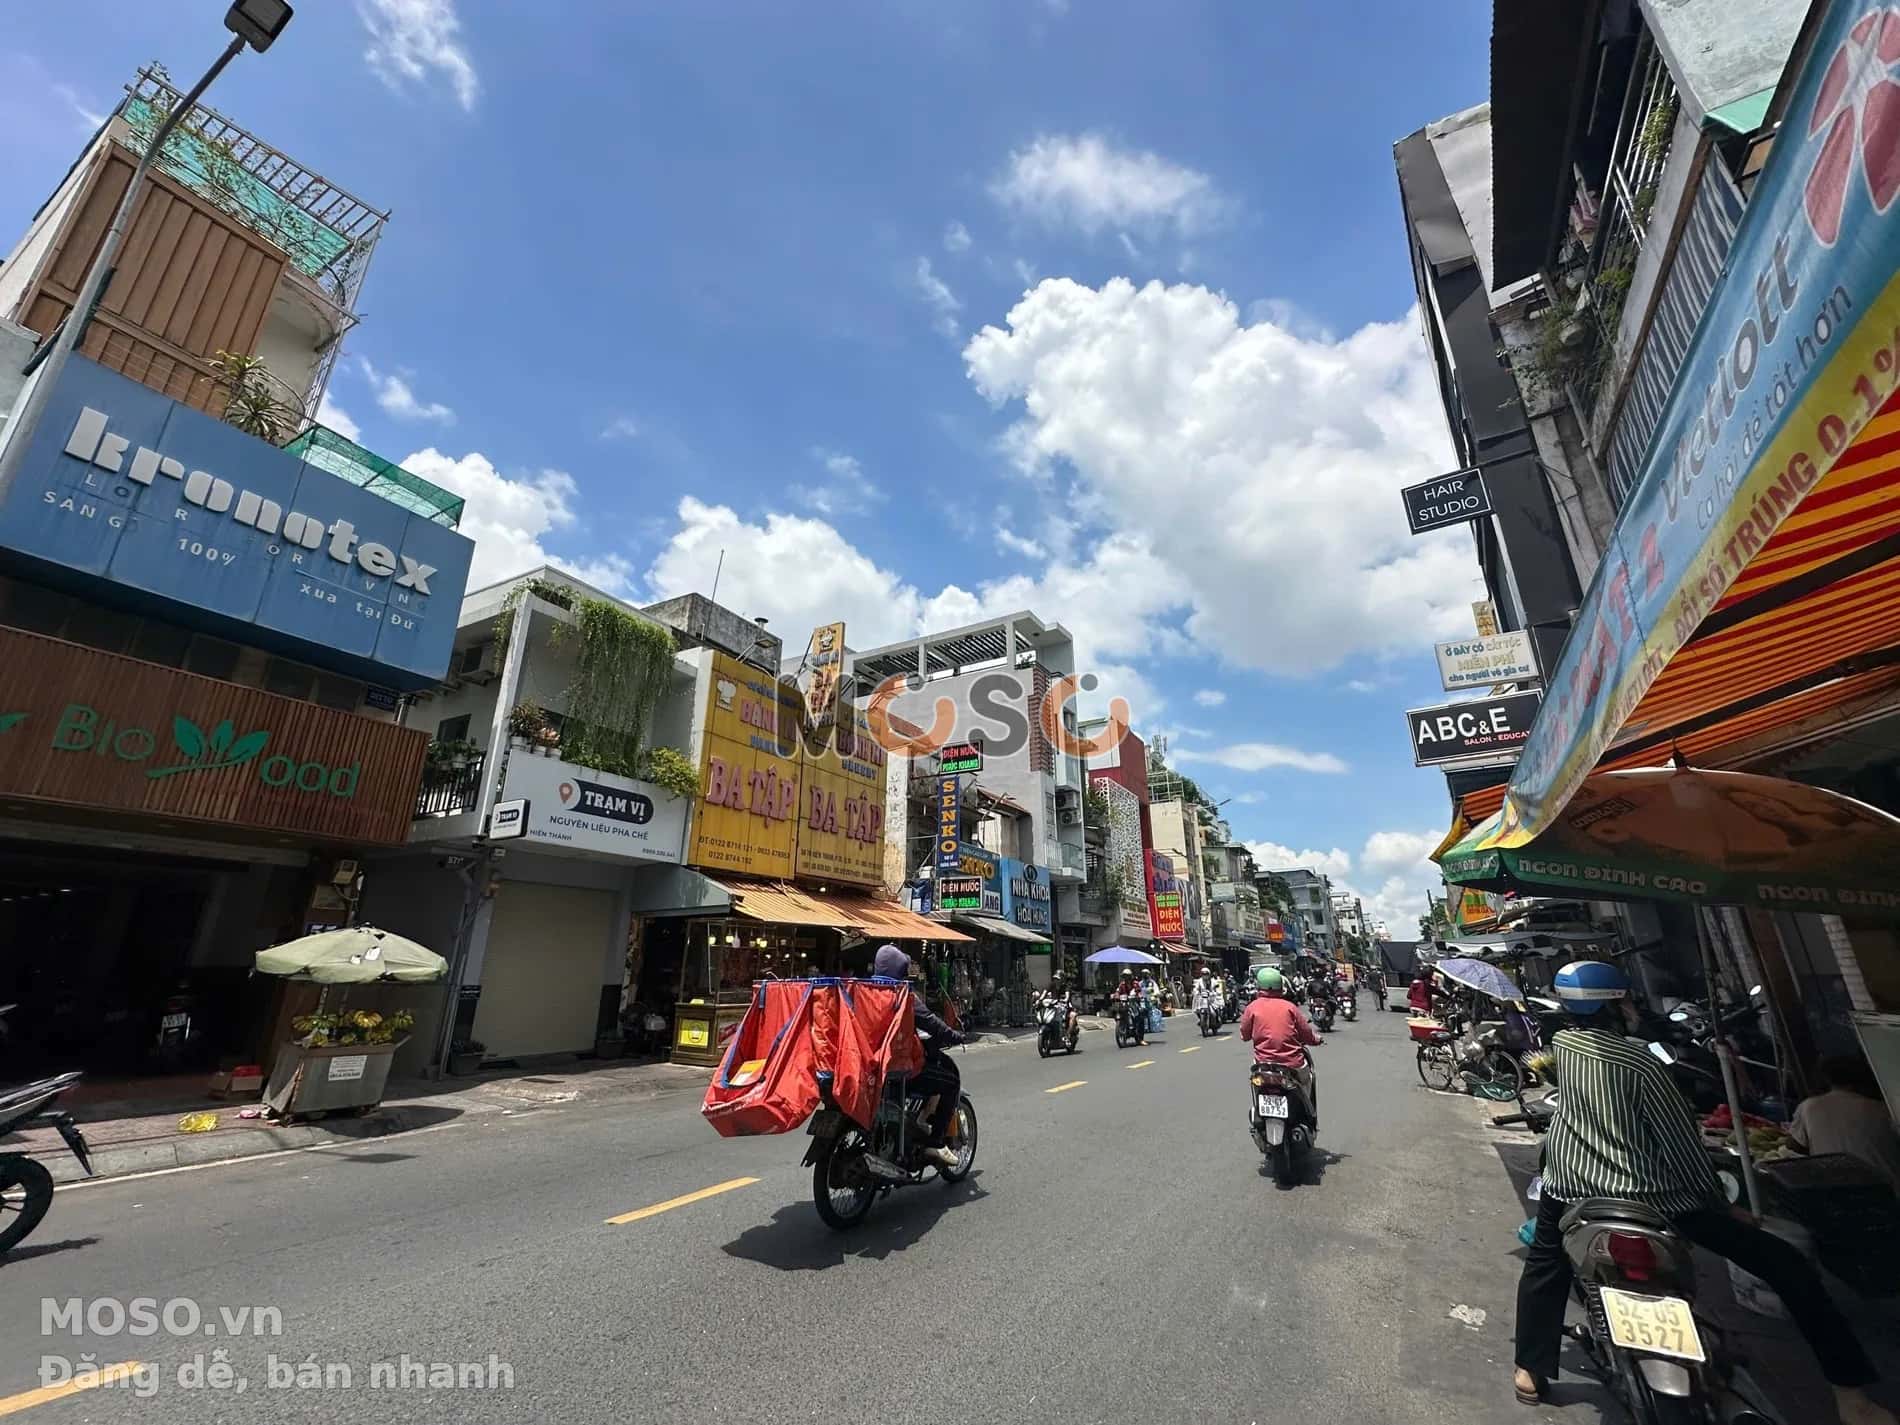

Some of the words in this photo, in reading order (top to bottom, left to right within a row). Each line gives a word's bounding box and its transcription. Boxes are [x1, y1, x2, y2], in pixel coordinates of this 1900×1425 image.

[64, 405, 439, 595] kronotex
[1423, 479, 1465, 500] HAIR
[1418, 495, 1479, 521] STUDIO
[1725, 452, 1818, 568] TRÚNG
[1449, 671, 1465, 682] cho
[1417, 706, 1511, 745] ABC&E
[1464, 735, 1493, 746] SALON
[584, 789, 627, 815] TRẠM
[630, 797, 646, 821] VỊ
[706, 758, 746, 812] BA
[748, 767, 796, 828] TẬP
[550, 815, 589, 830] NGUYÊN
[591, 820, 611, 835] LIỆU
[612, 827, 630, 838] PHA
[631, 828, 649, 841] CHẾ
[807, 786, 839, 833] BA
[844, 789, 882, 850] TẬP
[940, 780, 957, 852] SENKO
[1012, 879, 1029, 898] NHA
[1030, 882, 1050, 901] KHOA
[1652, 874, 1707, 893] CAO
[1622, 1319, 1684, 1353] 3527
